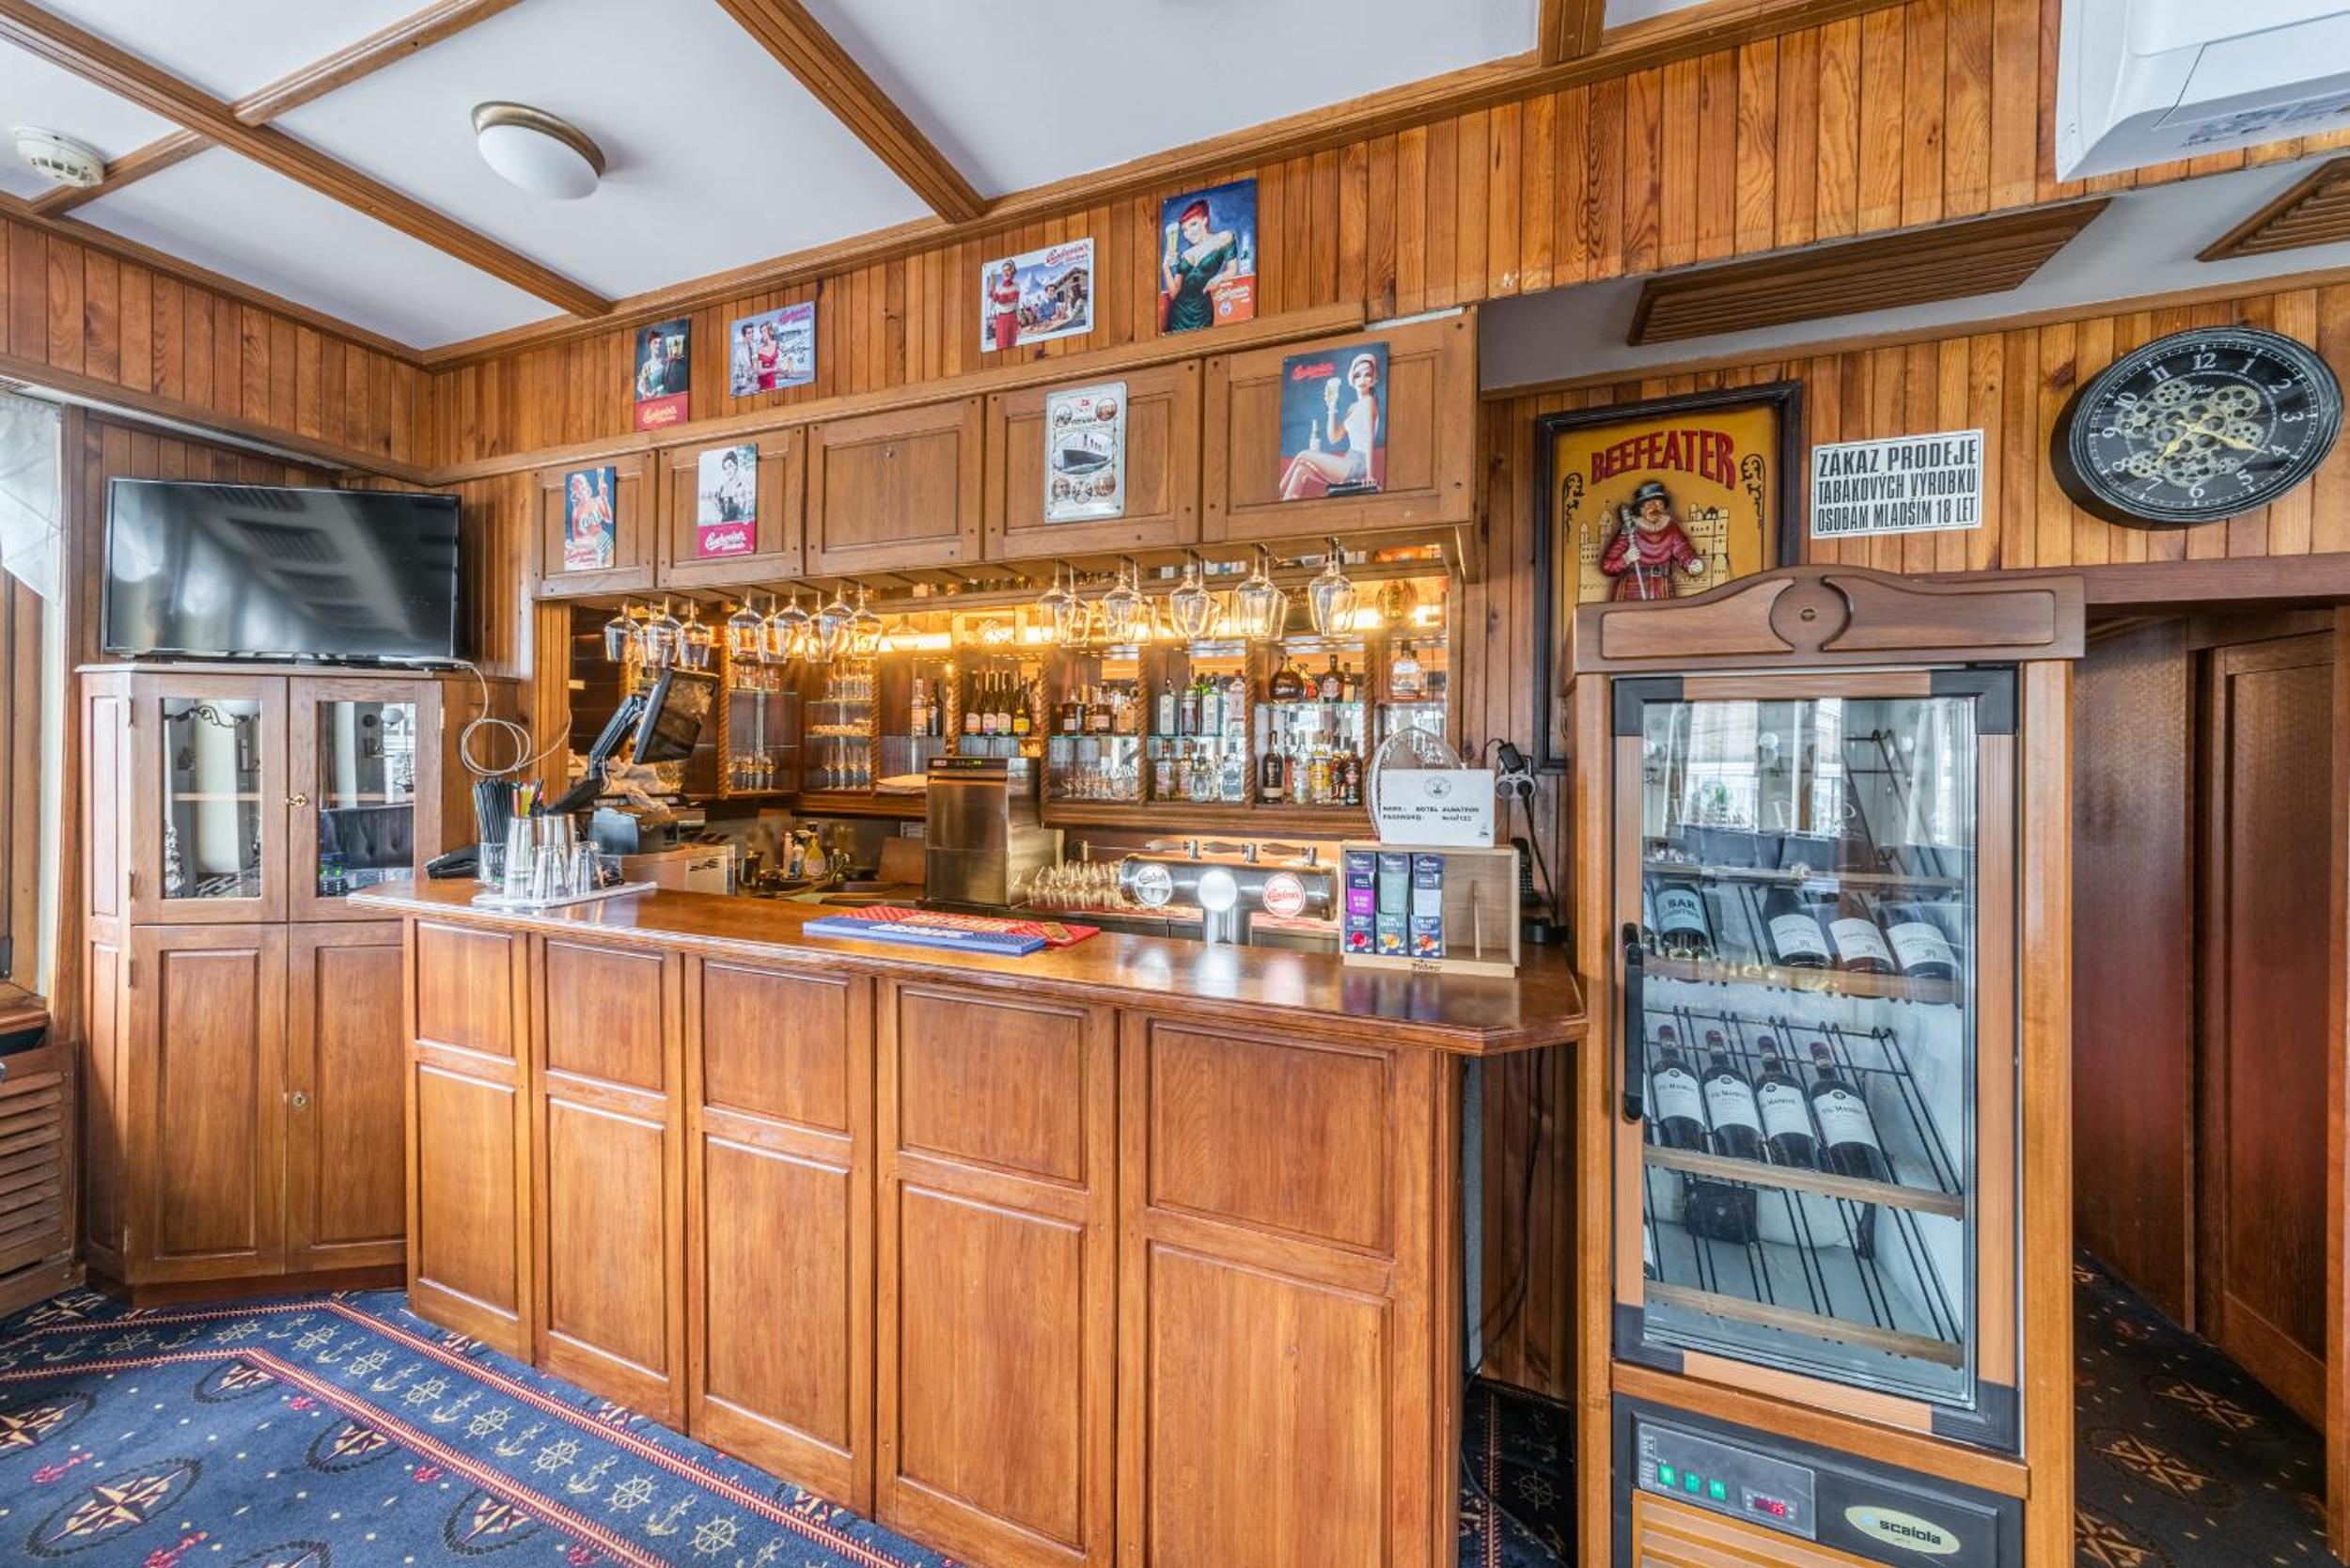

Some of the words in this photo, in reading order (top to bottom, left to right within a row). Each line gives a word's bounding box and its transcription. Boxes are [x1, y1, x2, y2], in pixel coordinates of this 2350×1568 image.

[2193, 352, 2217, 370] 12
[2238, 358, 2255, 374] 1
[2148, 365, 2172, 383] 11
[2268, 379, 2291, 395] 2
[2113, 392, 2138, 411] 10
[2282, 412, 2304, 422] 3
[2102, 428, 2123, 439] 9
[1819, 448, 1880, 478] ZÁKAZ
[1887, 438, 1978, 472] PRODEJE
[2270, 445, 2291, 457] 4
[1590, 429, 1736, 491] BEEFEATER
[2112, 461, 2132, 472] 8
[2148, 476, 2164, 491] 7
[2236, 472, 2253, 486] 5
[2188, 482, 2205, 498] 6
[1936, 498, 1952, 525] 18
[1956, 498, 1976, 524] LET
